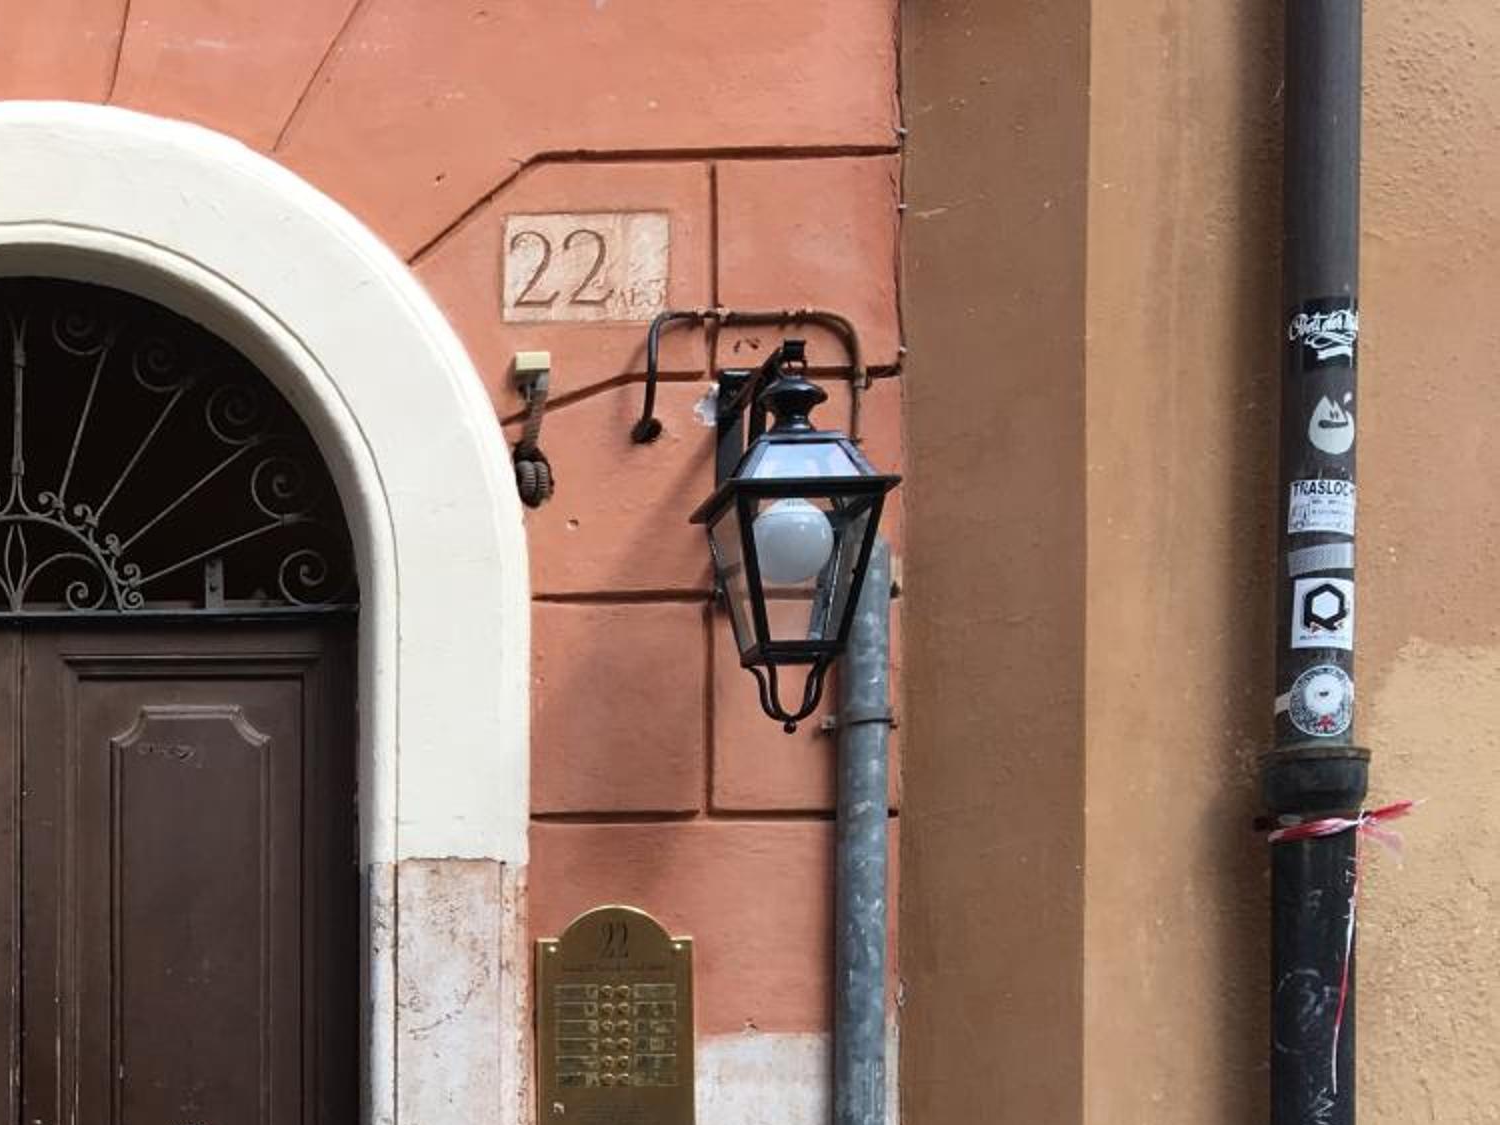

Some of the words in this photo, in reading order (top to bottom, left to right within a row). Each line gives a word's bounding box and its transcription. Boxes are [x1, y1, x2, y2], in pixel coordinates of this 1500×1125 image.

[509, 229, 613, 309] 22
[1292, 480, 1355, 497] TRASLOC
[597, 920, 630, 960] 22
